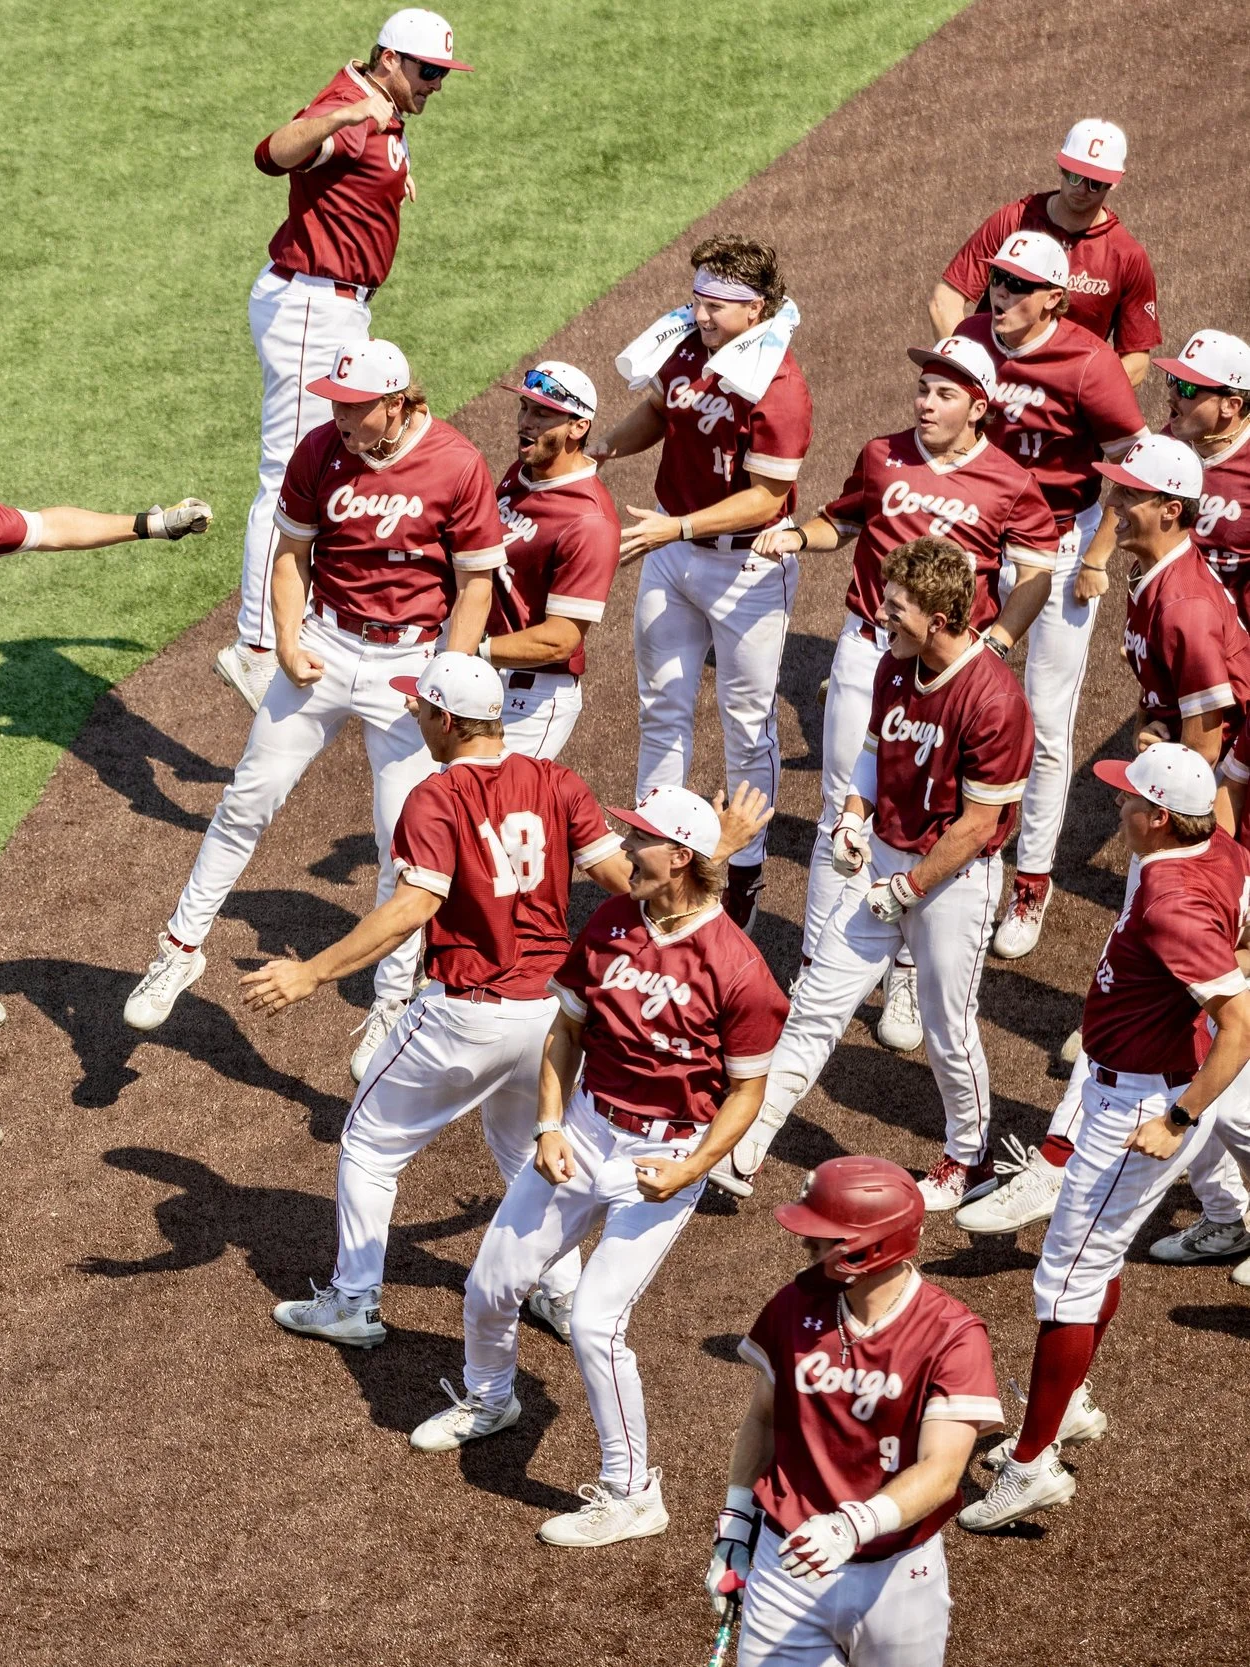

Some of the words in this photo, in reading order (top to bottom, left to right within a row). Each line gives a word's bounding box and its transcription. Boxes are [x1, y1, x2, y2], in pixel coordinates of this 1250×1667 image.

[1087, 138, 1104, 159] C
[1008, 238, 1028, 258] C
[941, 338, 960, 356] C
[1184, 338, 1205, 360] C
[336, 355, 354, 379] C
[1124, 442, 1145, 464] C
[326, 484, 424, 539] Cougs
[881, 480, 980, 537] Cougs
[478, 810, 547, 898] 18
[794, 1350, 904, 1422] Cougs
[878, 1435, 901, 1473] 9
